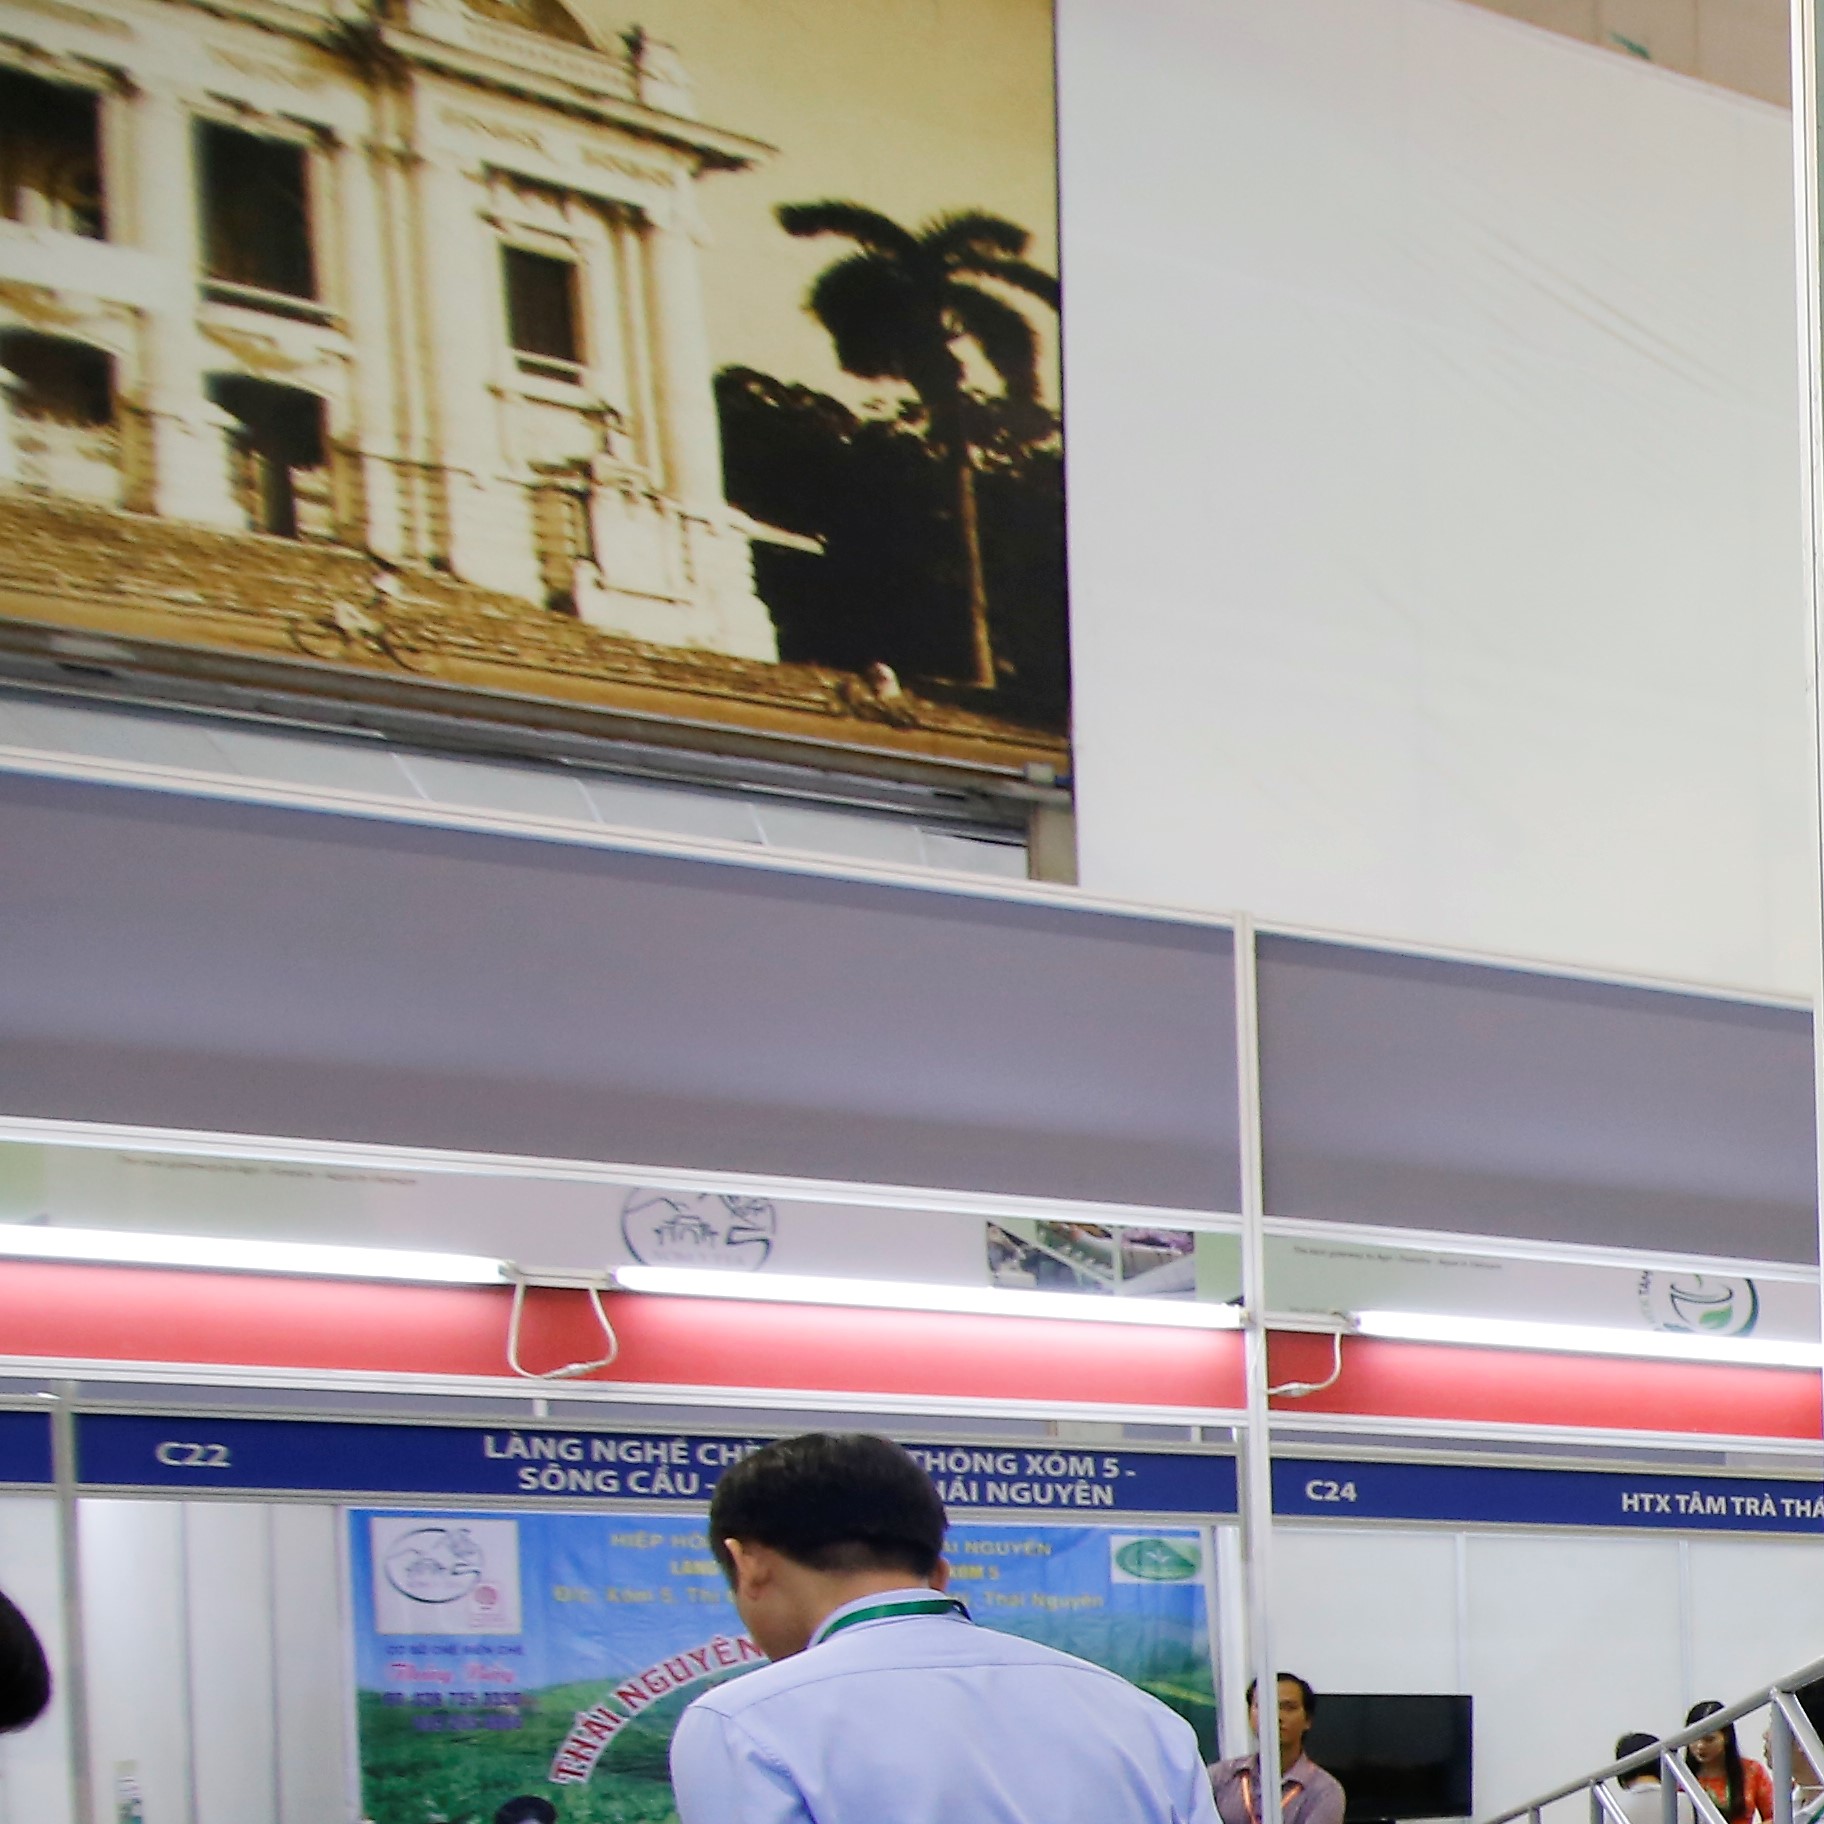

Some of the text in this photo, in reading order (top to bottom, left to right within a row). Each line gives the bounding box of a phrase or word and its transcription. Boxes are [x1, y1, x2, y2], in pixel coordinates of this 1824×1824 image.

[155, 1441, 232, 1468] C22
[484, 1431, 584, 1462] LÀNG
[518, 1463, 621, 1493] SÔNG
[1102, 1457, 1120, 1478] 5
[986, 1477, 1115, 1506] NGUYÊN
[1305, 1479, 1358, 1502] C24
[1621, 1492, 1672, 1514] HTX
[1675, 1490, 1727, 1515] TÂM
[1730, 1493, 1777, 1517] TRÀ
[549, 1634, 767, 1784] THÁI NGUYÊN
